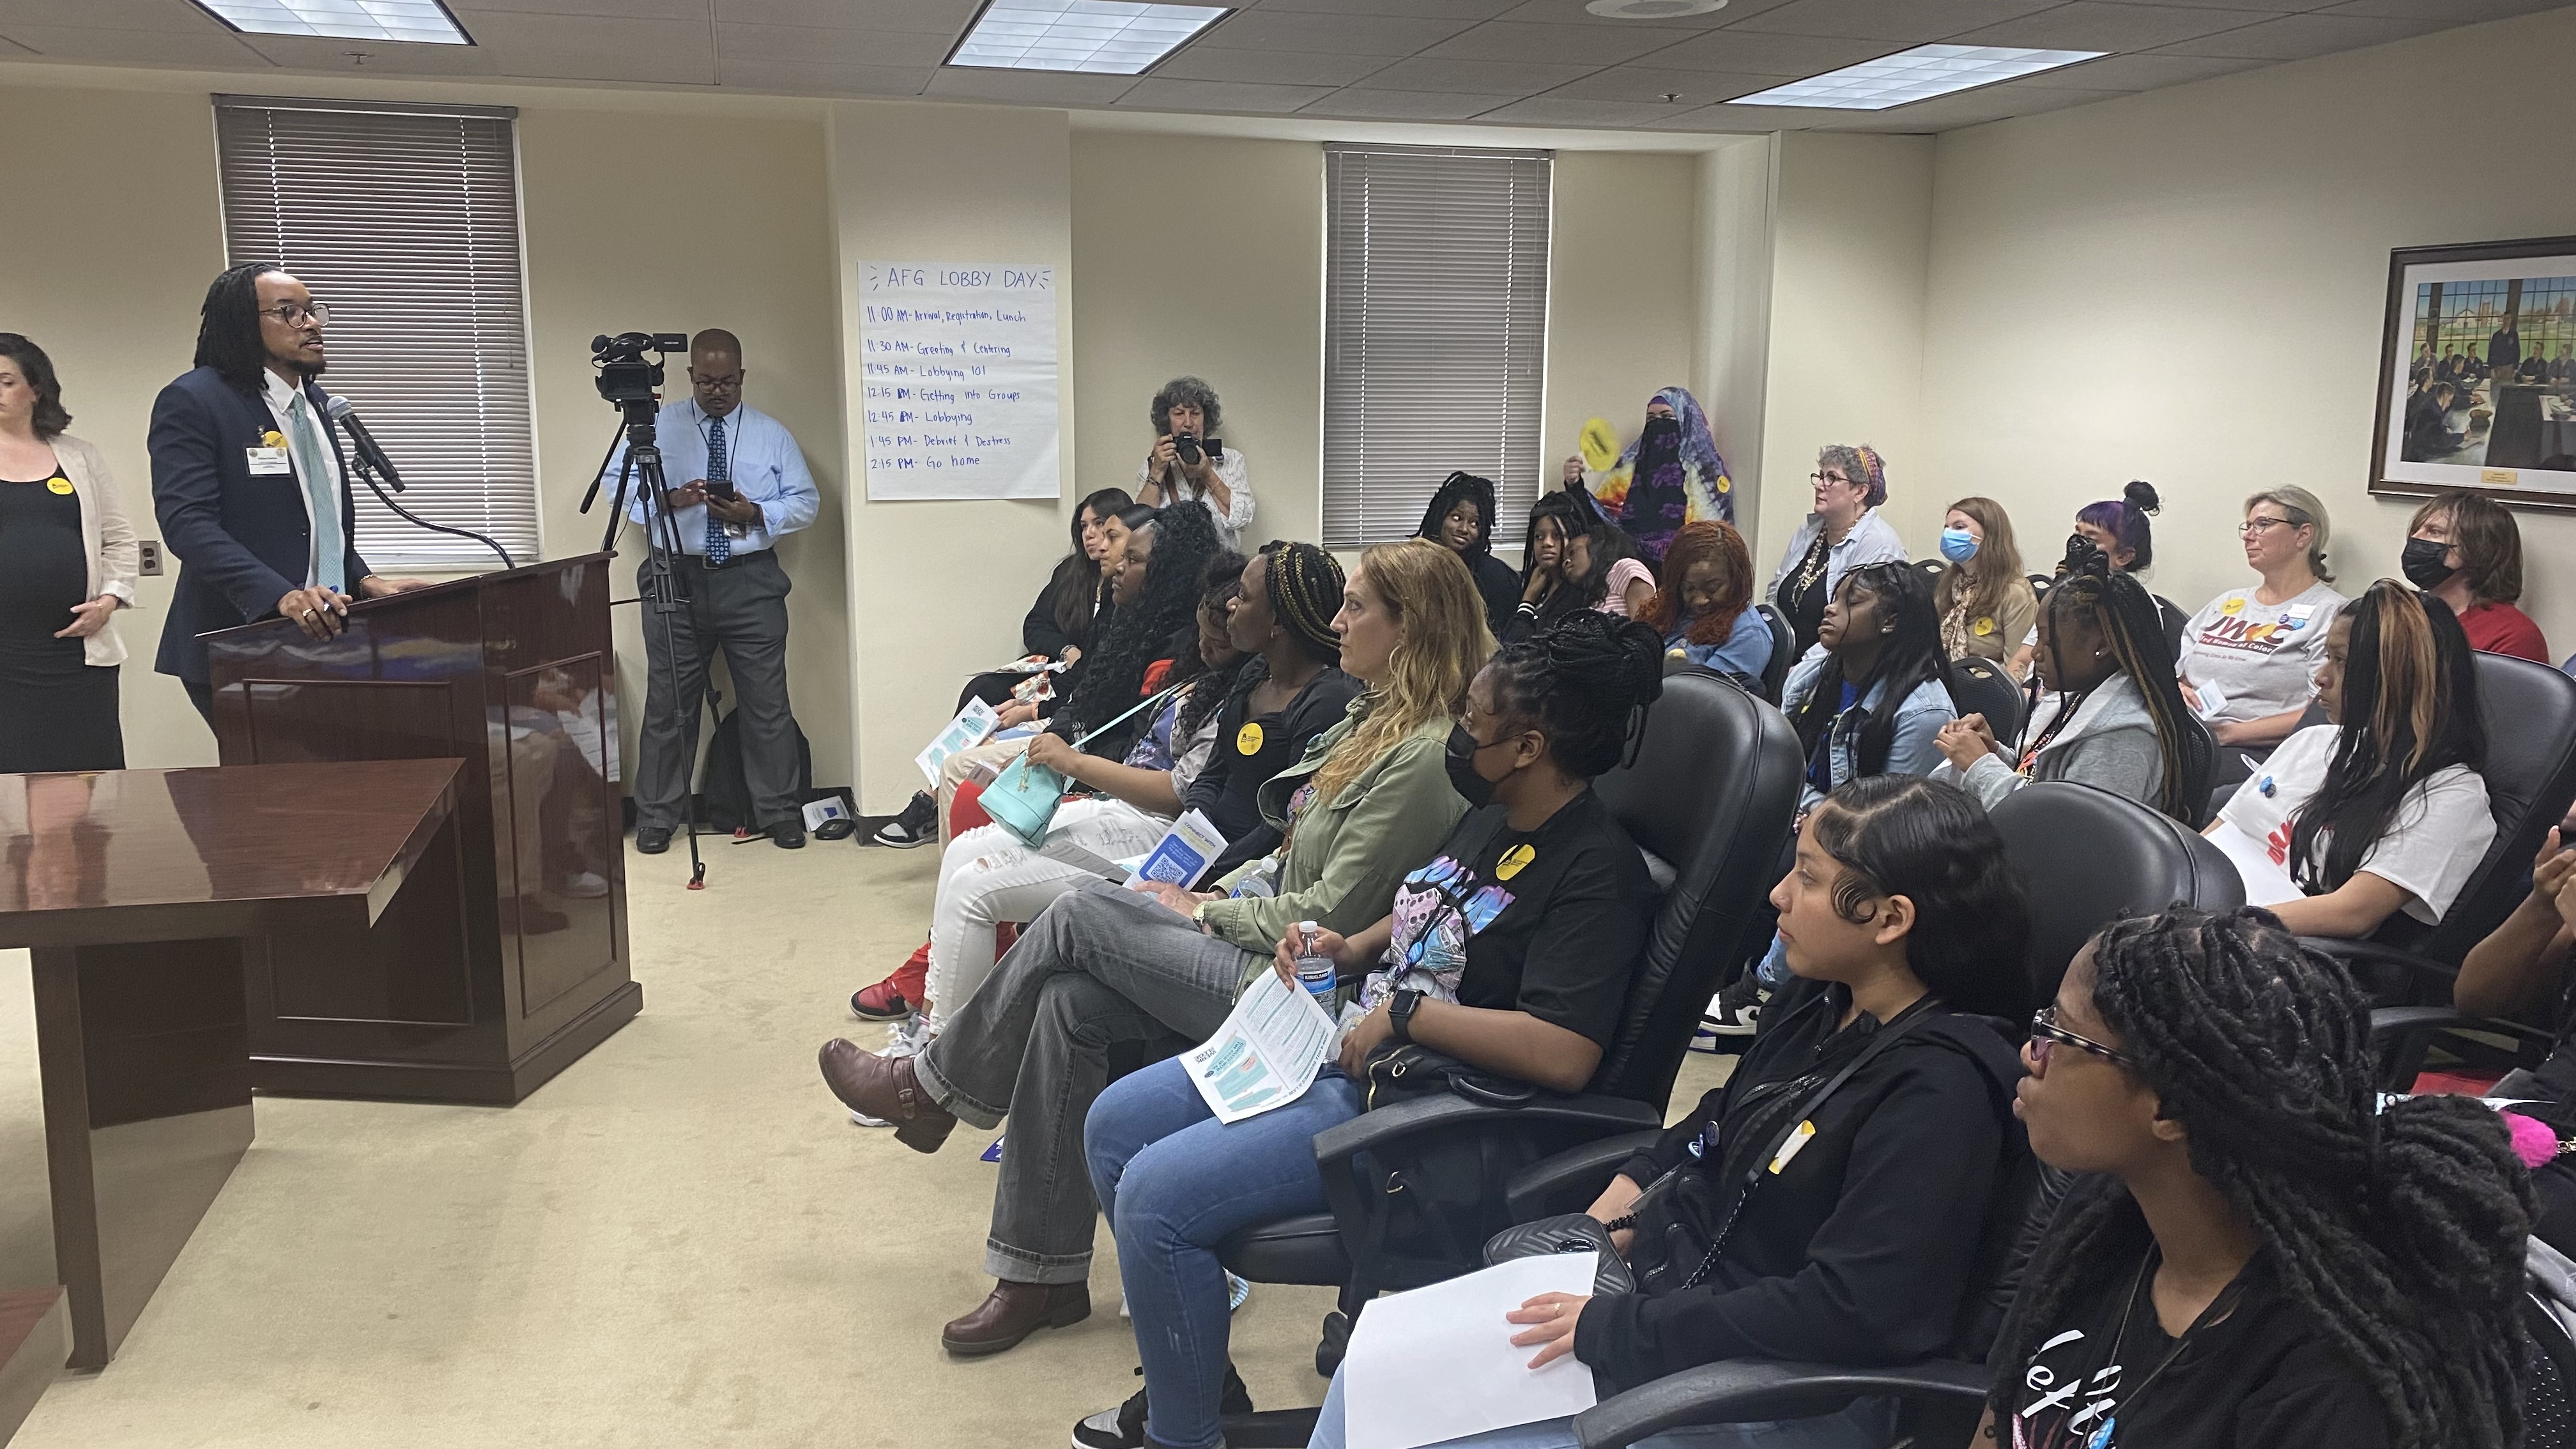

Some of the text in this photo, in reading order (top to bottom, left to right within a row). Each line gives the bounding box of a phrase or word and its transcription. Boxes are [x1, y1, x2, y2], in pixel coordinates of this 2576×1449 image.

[887, 268, 1038, 288] AFG LOBBY DAY
[997, 309, 1026, 322] Lunch
[917, 343, 954, 356] Greeting
[960, 340, 966, 353] &
[974, 342, 1011, 358] Centering
[867, 362, 889, 375] 11:45
[919, 365, 965, 381] Lobbying
[971, 365, 986, 376] 101
[868, 386, 891, 399] 12:15
[920, 390, 954, 404] Getting
[965, 390, 981, 400] into
[988, 390, 1020, 403] Groups
[868, 410, 894, 423] 12:45
[924, 410, 972, 427] Lobbying
[870, 435, 892, 448] 1:45
[924, 434, 957, 447] Debrief
[964, 434, 969, 447] &
[975, 436, 1011, 447] Destress
[870, 458, 892, 470] 2:15
[926, 456, 942, 470] Go
[951, 454, 980, 467] home
[2248, 643, 2273, 654] Color
[1305, 972, 1328, 980] KIRKLAND
